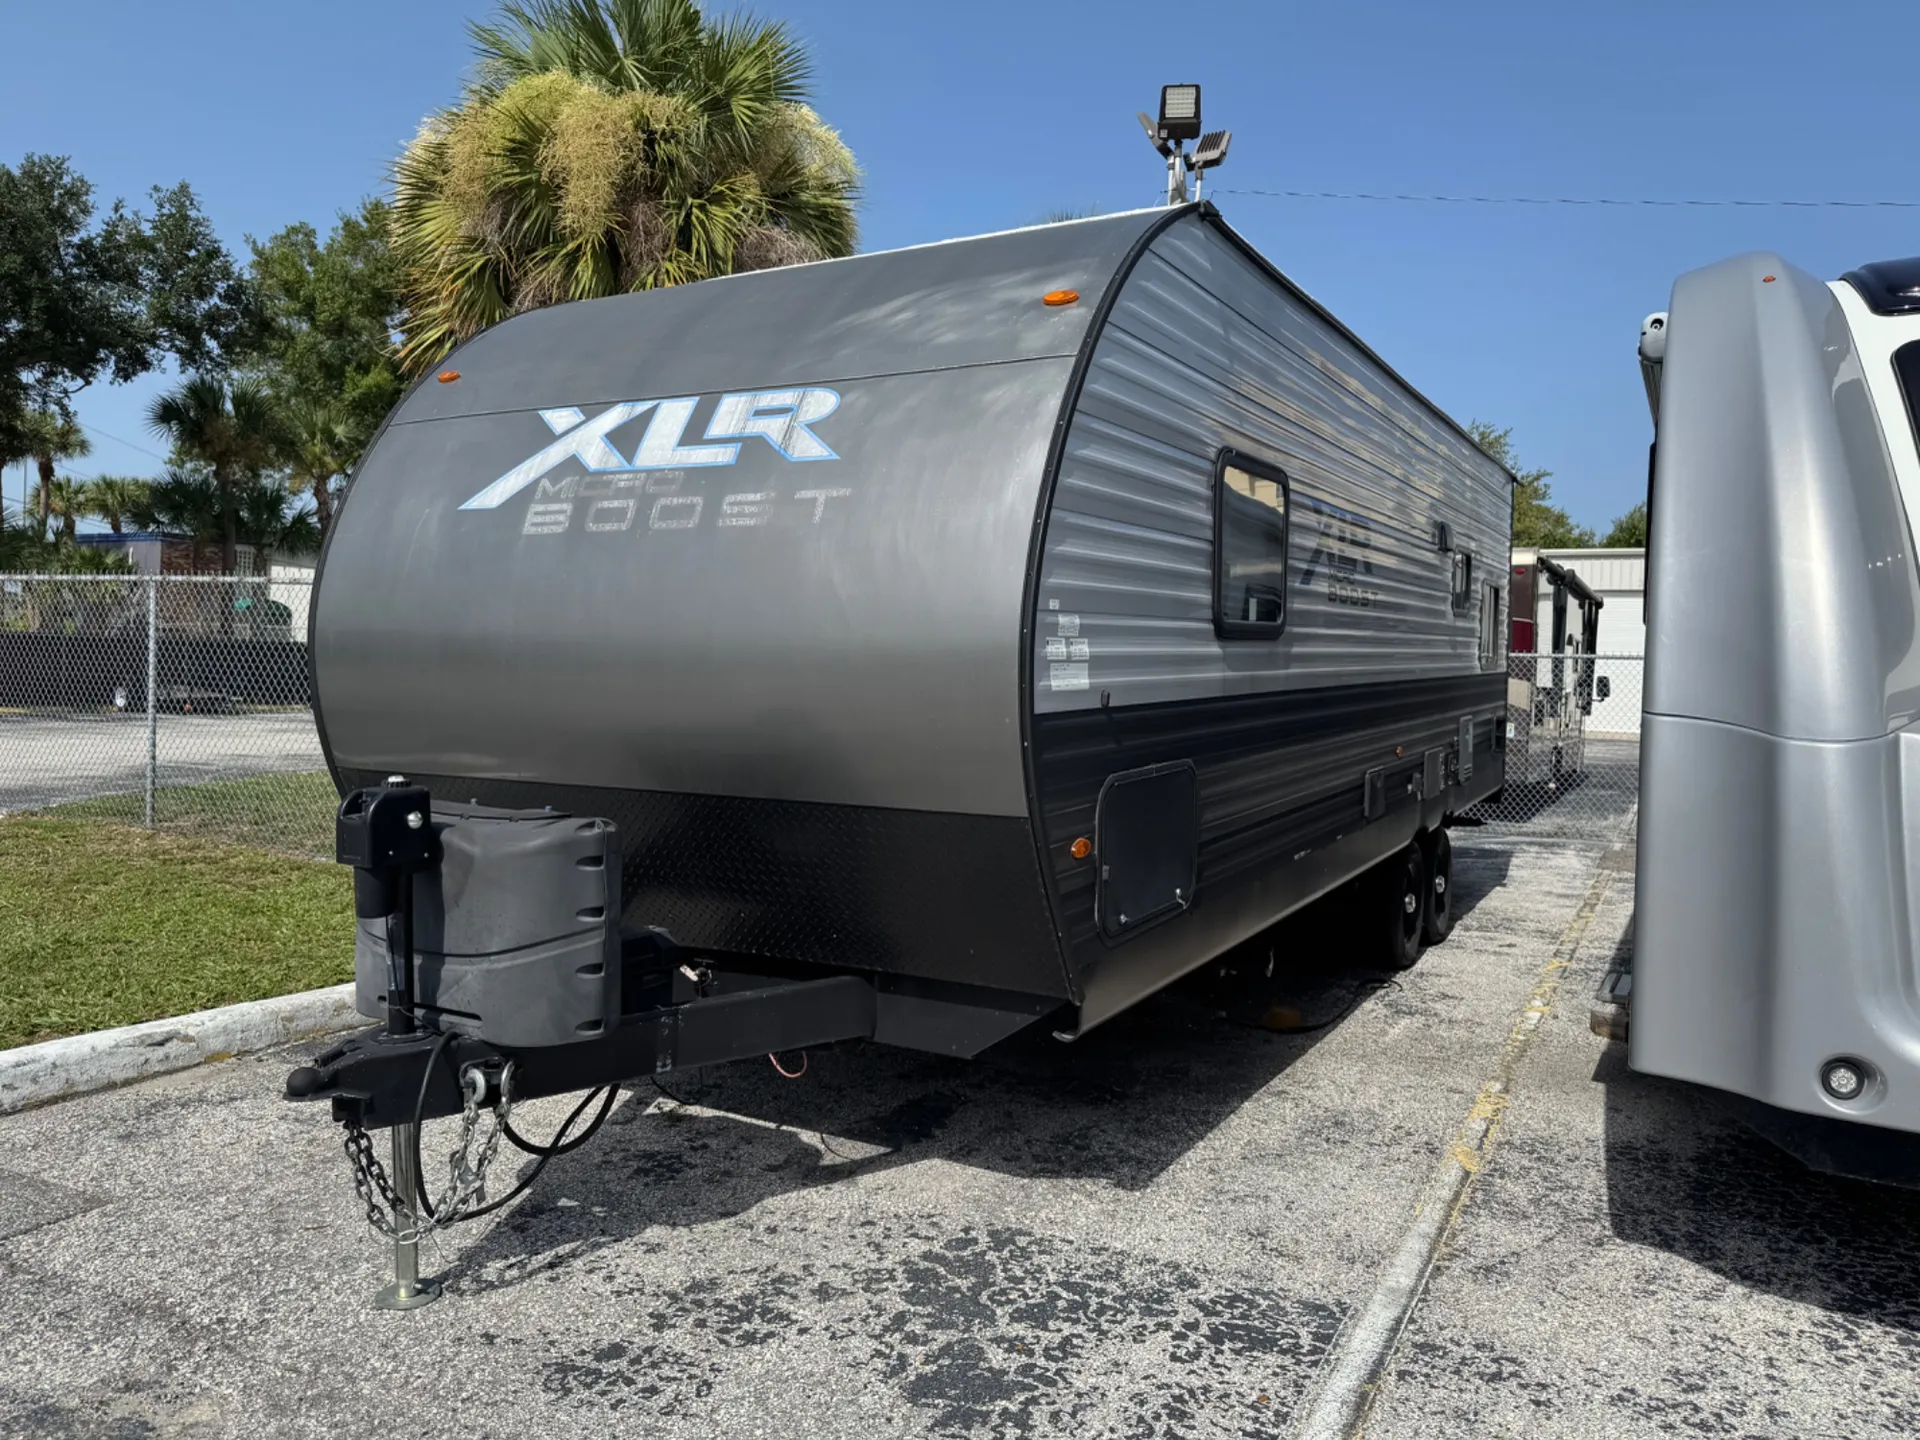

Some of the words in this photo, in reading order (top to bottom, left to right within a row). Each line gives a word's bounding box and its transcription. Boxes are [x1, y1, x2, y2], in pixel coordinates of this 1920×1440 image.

[458, 388, 841, 510] XLR
[523, 487, 852, 535] BOOST
[1328, 586, 1378, 608] BOOST
